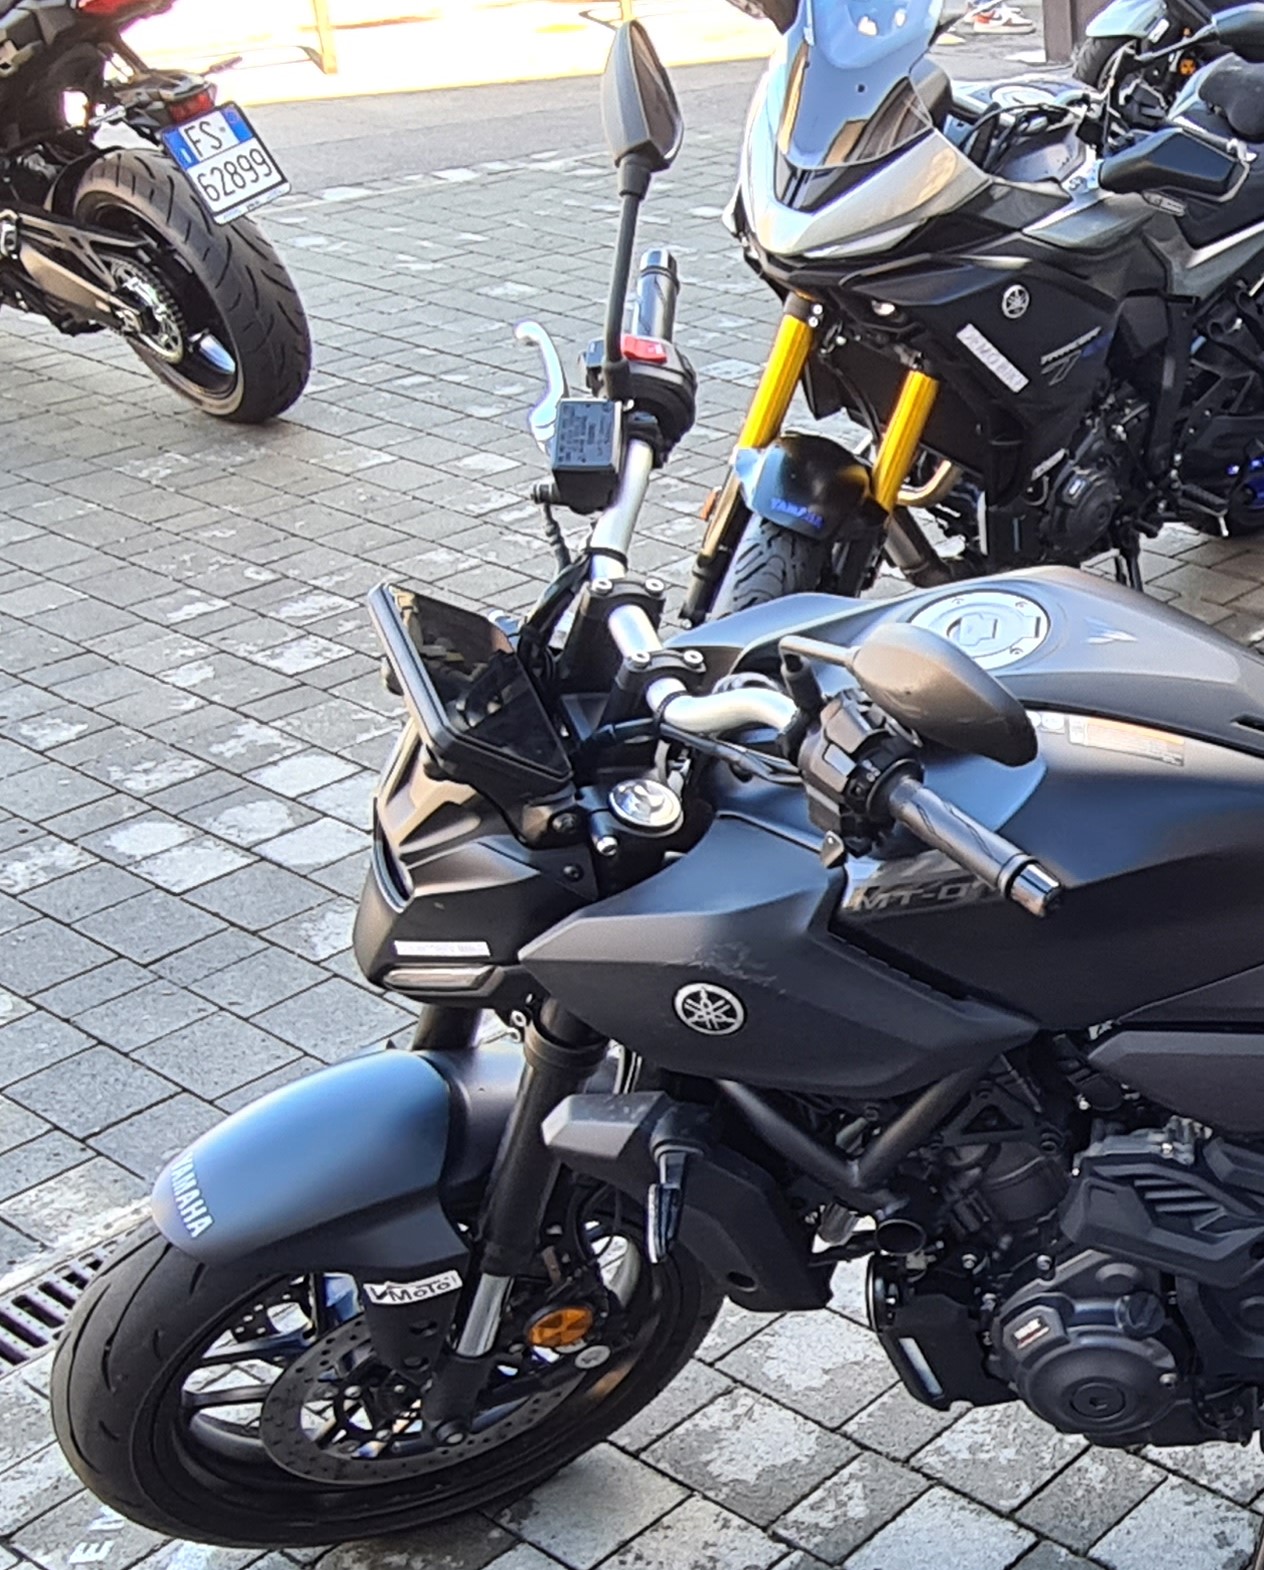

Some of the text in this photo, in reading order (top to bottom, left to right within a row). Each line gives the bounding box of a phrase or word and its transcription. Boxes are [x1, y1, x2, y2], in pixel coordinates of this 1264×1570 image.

[183, 120, 223, 158] FS
[197, 148, 272, 201] 62899
[171, 1150, 214, 1238] YAMAHA
